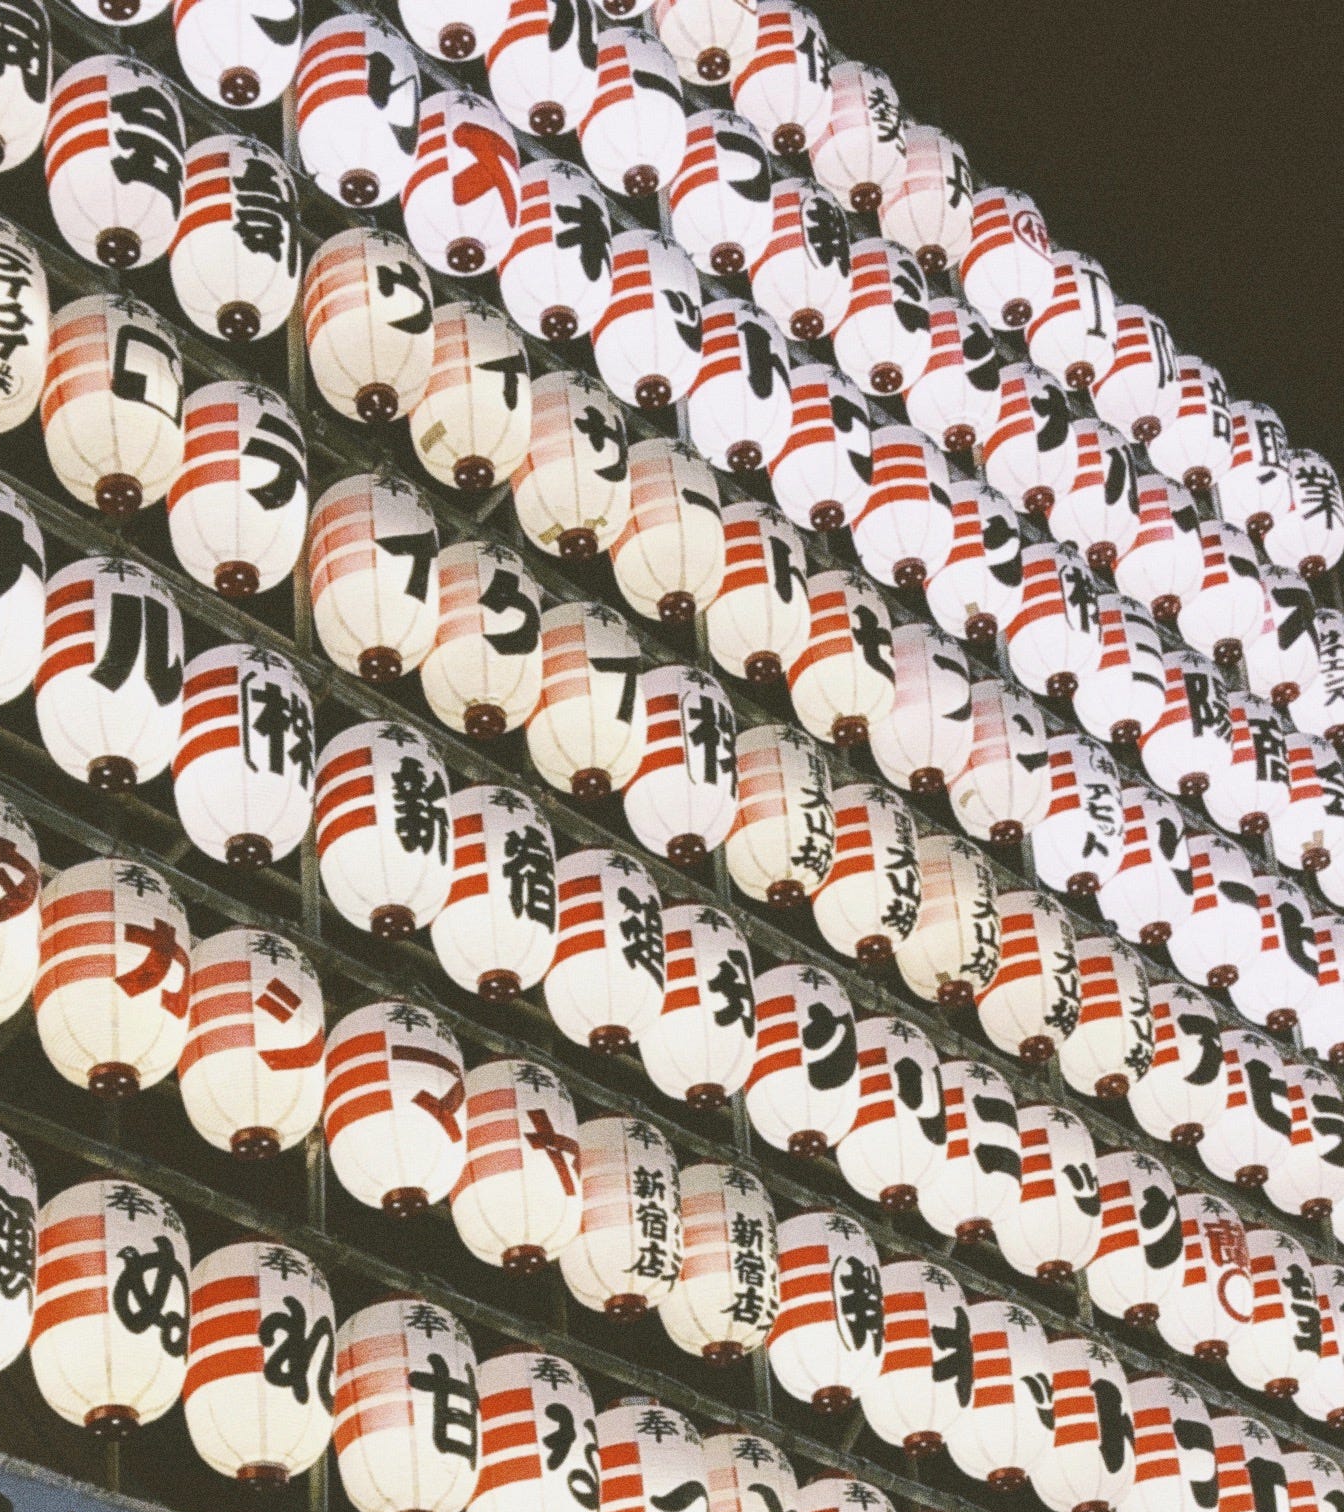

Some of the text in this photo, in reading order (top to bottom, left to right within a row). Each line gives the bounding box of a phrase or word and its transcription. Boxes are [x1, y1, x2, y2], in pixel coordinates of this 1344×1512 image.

[624, 1166, 669, 1280] 新宿店
[721, 1213, 765, 1324] 新宿店
